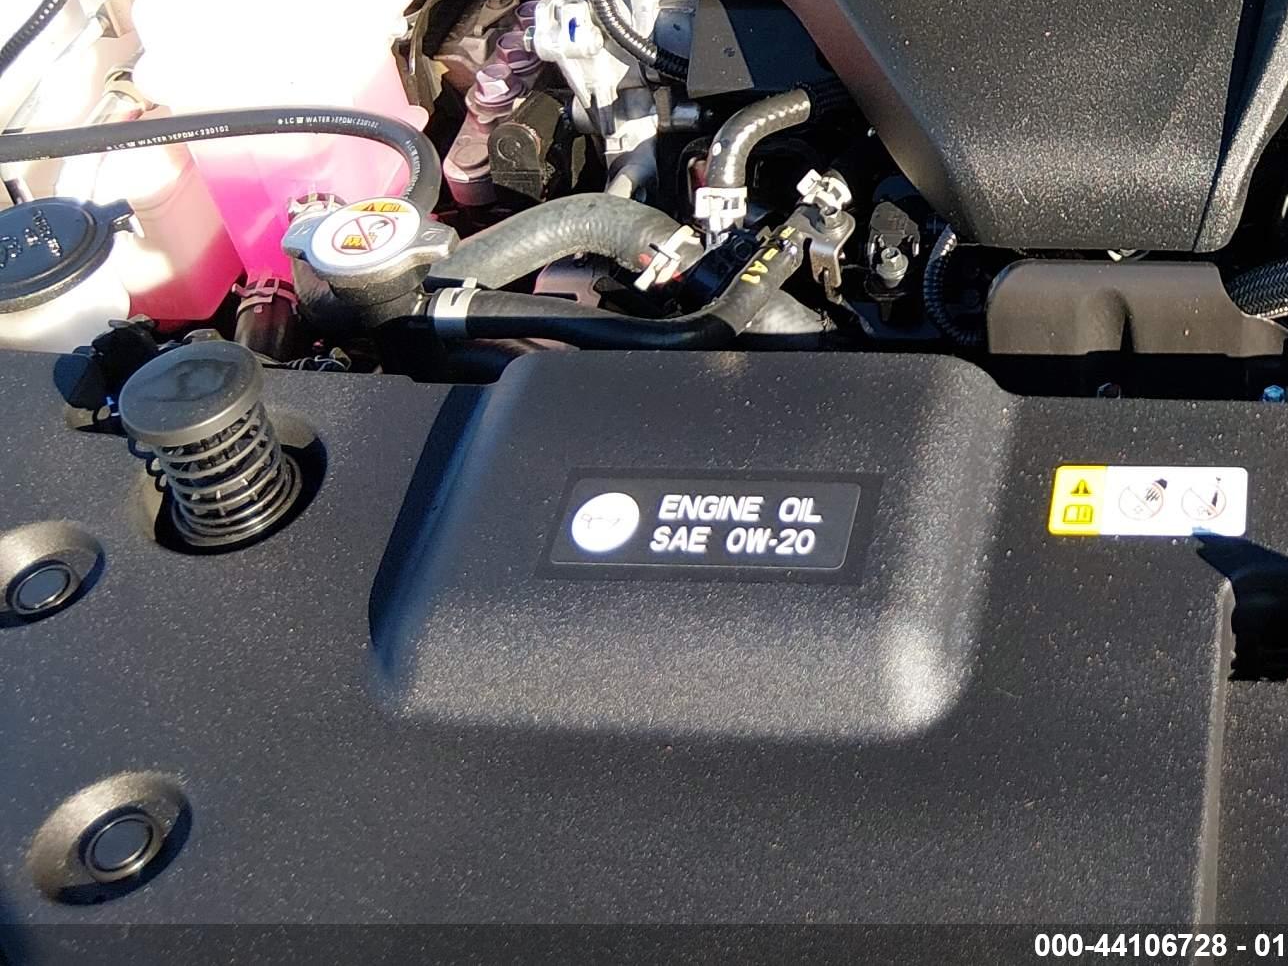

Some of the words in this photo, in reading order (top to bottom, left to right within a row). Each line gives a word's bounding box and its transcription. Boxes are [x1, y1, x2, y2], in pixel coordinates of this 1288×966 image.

[658, 494, 764, 522] ENGINE
[778, 497, 823, 523] OIL
[649, 526, 712, 553] SAE
[725, 527, 816, 555] 0W-20
